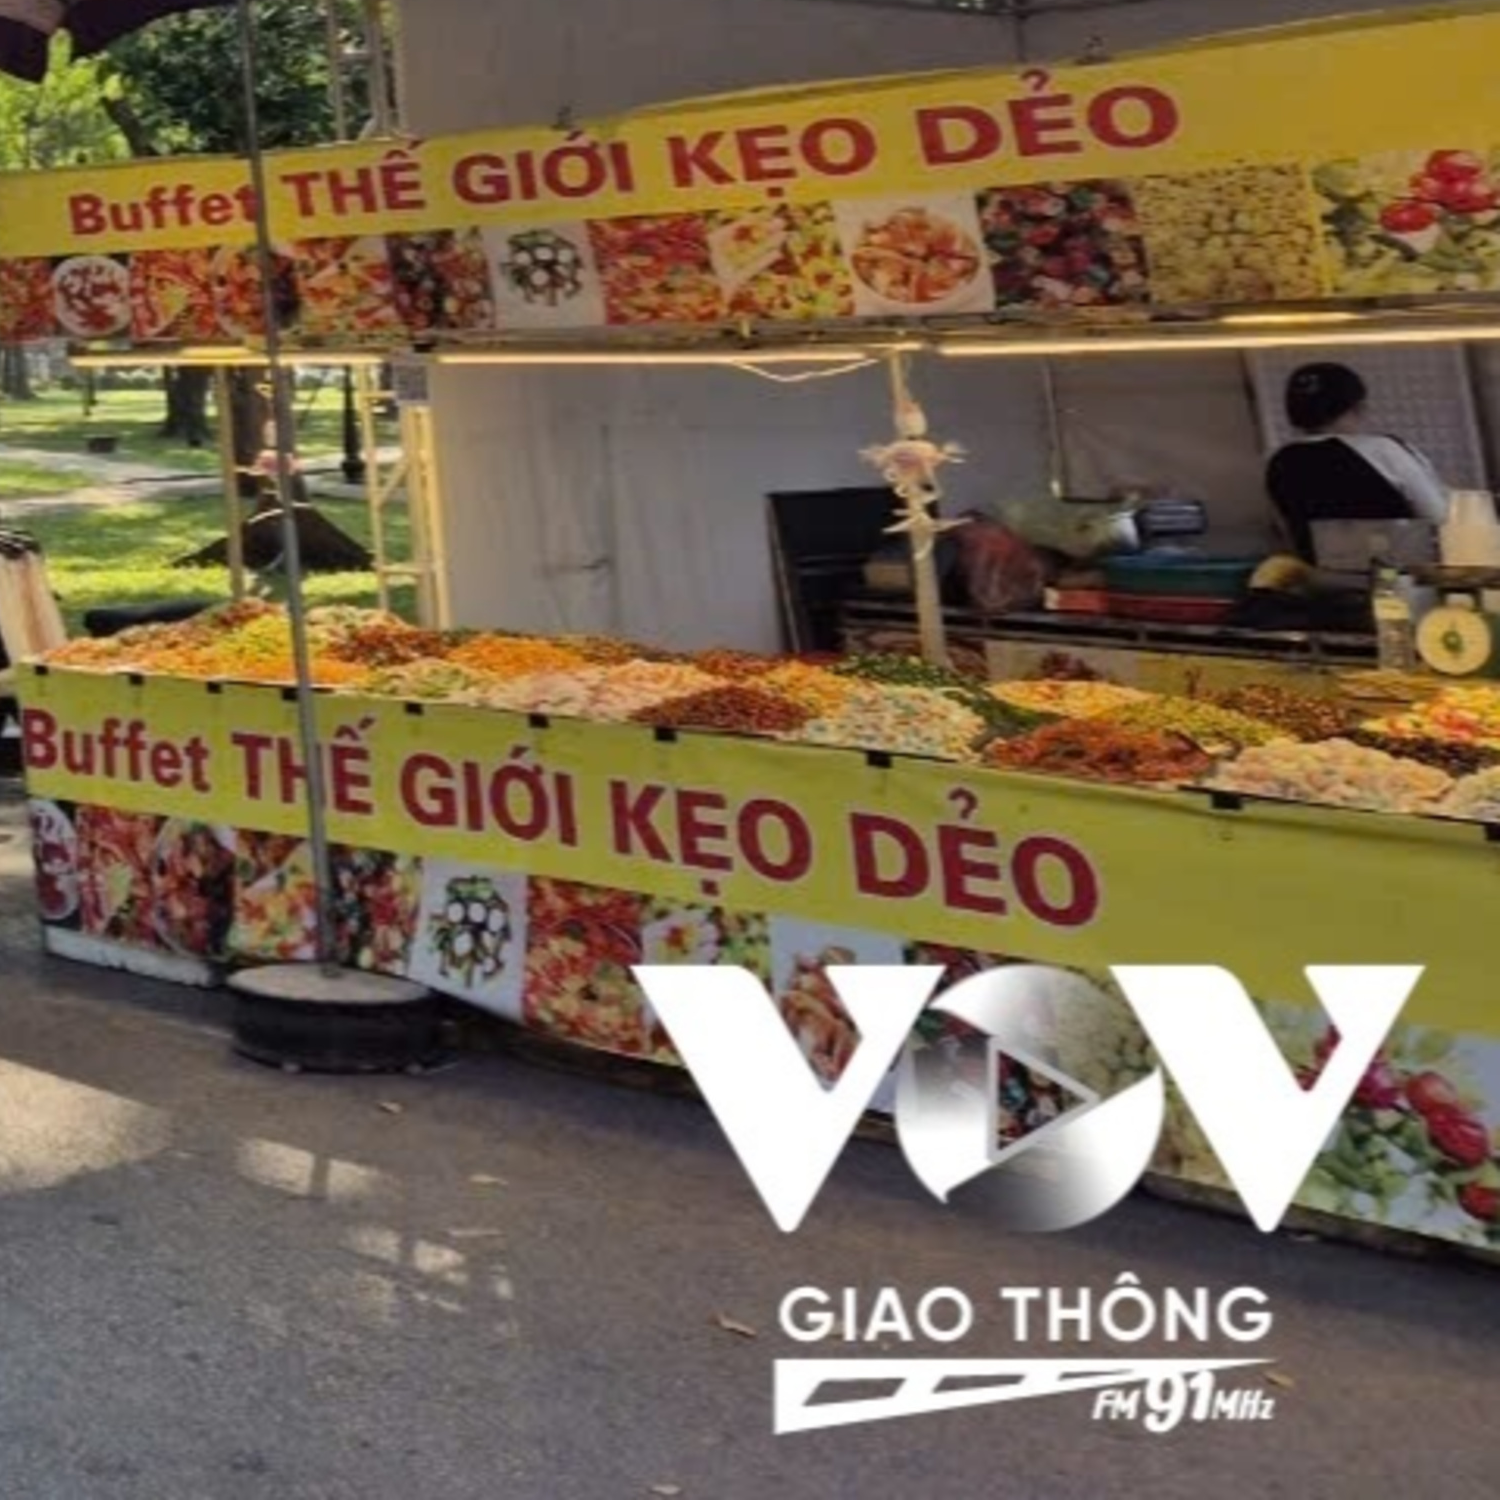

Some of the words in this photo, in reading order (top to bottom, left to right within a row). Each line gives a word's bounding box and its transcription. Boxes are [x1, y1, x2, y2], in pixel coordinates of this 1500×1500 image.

[68, 183, 260, 237] Buffet
[280, 140, 426, 217] THẾ
[452, 131, 634, 206] GIỚI
[665, 117, 878, 198] KẸO
[915, 68, 1180, 166] DẺO
[21, 707, 211, 793] Buffet
[231, 716, 375, 816] THẾ
[400, 745, 578, 846] GIỚI
[608, 780, 813, 896] KẸO
[848, 787, 1099, 927] DẺO
